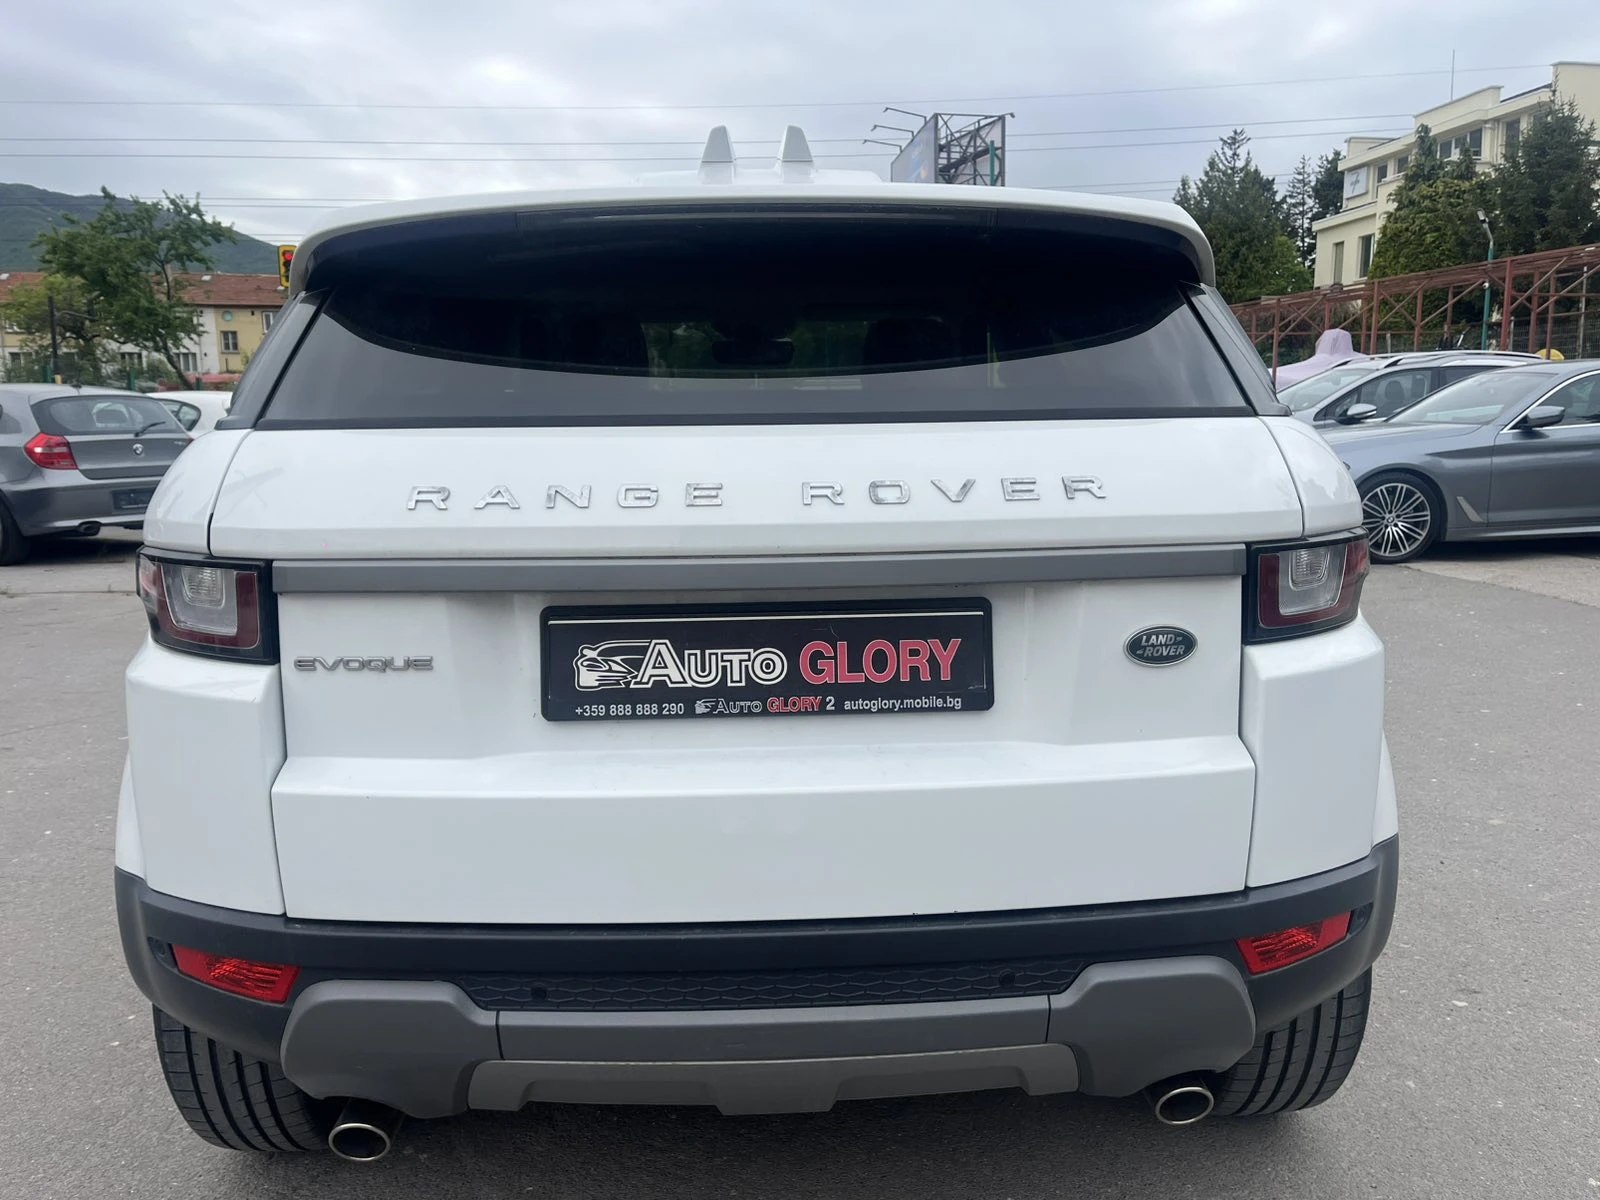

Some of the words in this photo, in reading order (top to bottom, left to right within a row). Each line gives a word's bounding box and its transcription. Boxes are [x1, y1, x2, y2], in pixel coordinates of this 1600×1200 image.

[407, 482, 723, 510] RANGE
[802, 475, 1107, 506] ROVER
[1141, 634, 1175, 646] LAND
[1144, 645, 1185, 657] ROVER
[294, 656, 433, 673] EVOQUE
[800, 639, 962, 685] GLORY
[575, 704, 606, 717] +359
[609, 704, 632, 716] 888
[636, 703, 659, 716] 888
[662, 703, 685, 715] 290
[767, 696, 822, 713] GLORY
[826, 696, 836, 711] 2
[844, 696, 962, 712] autoglory.mobile.bg
